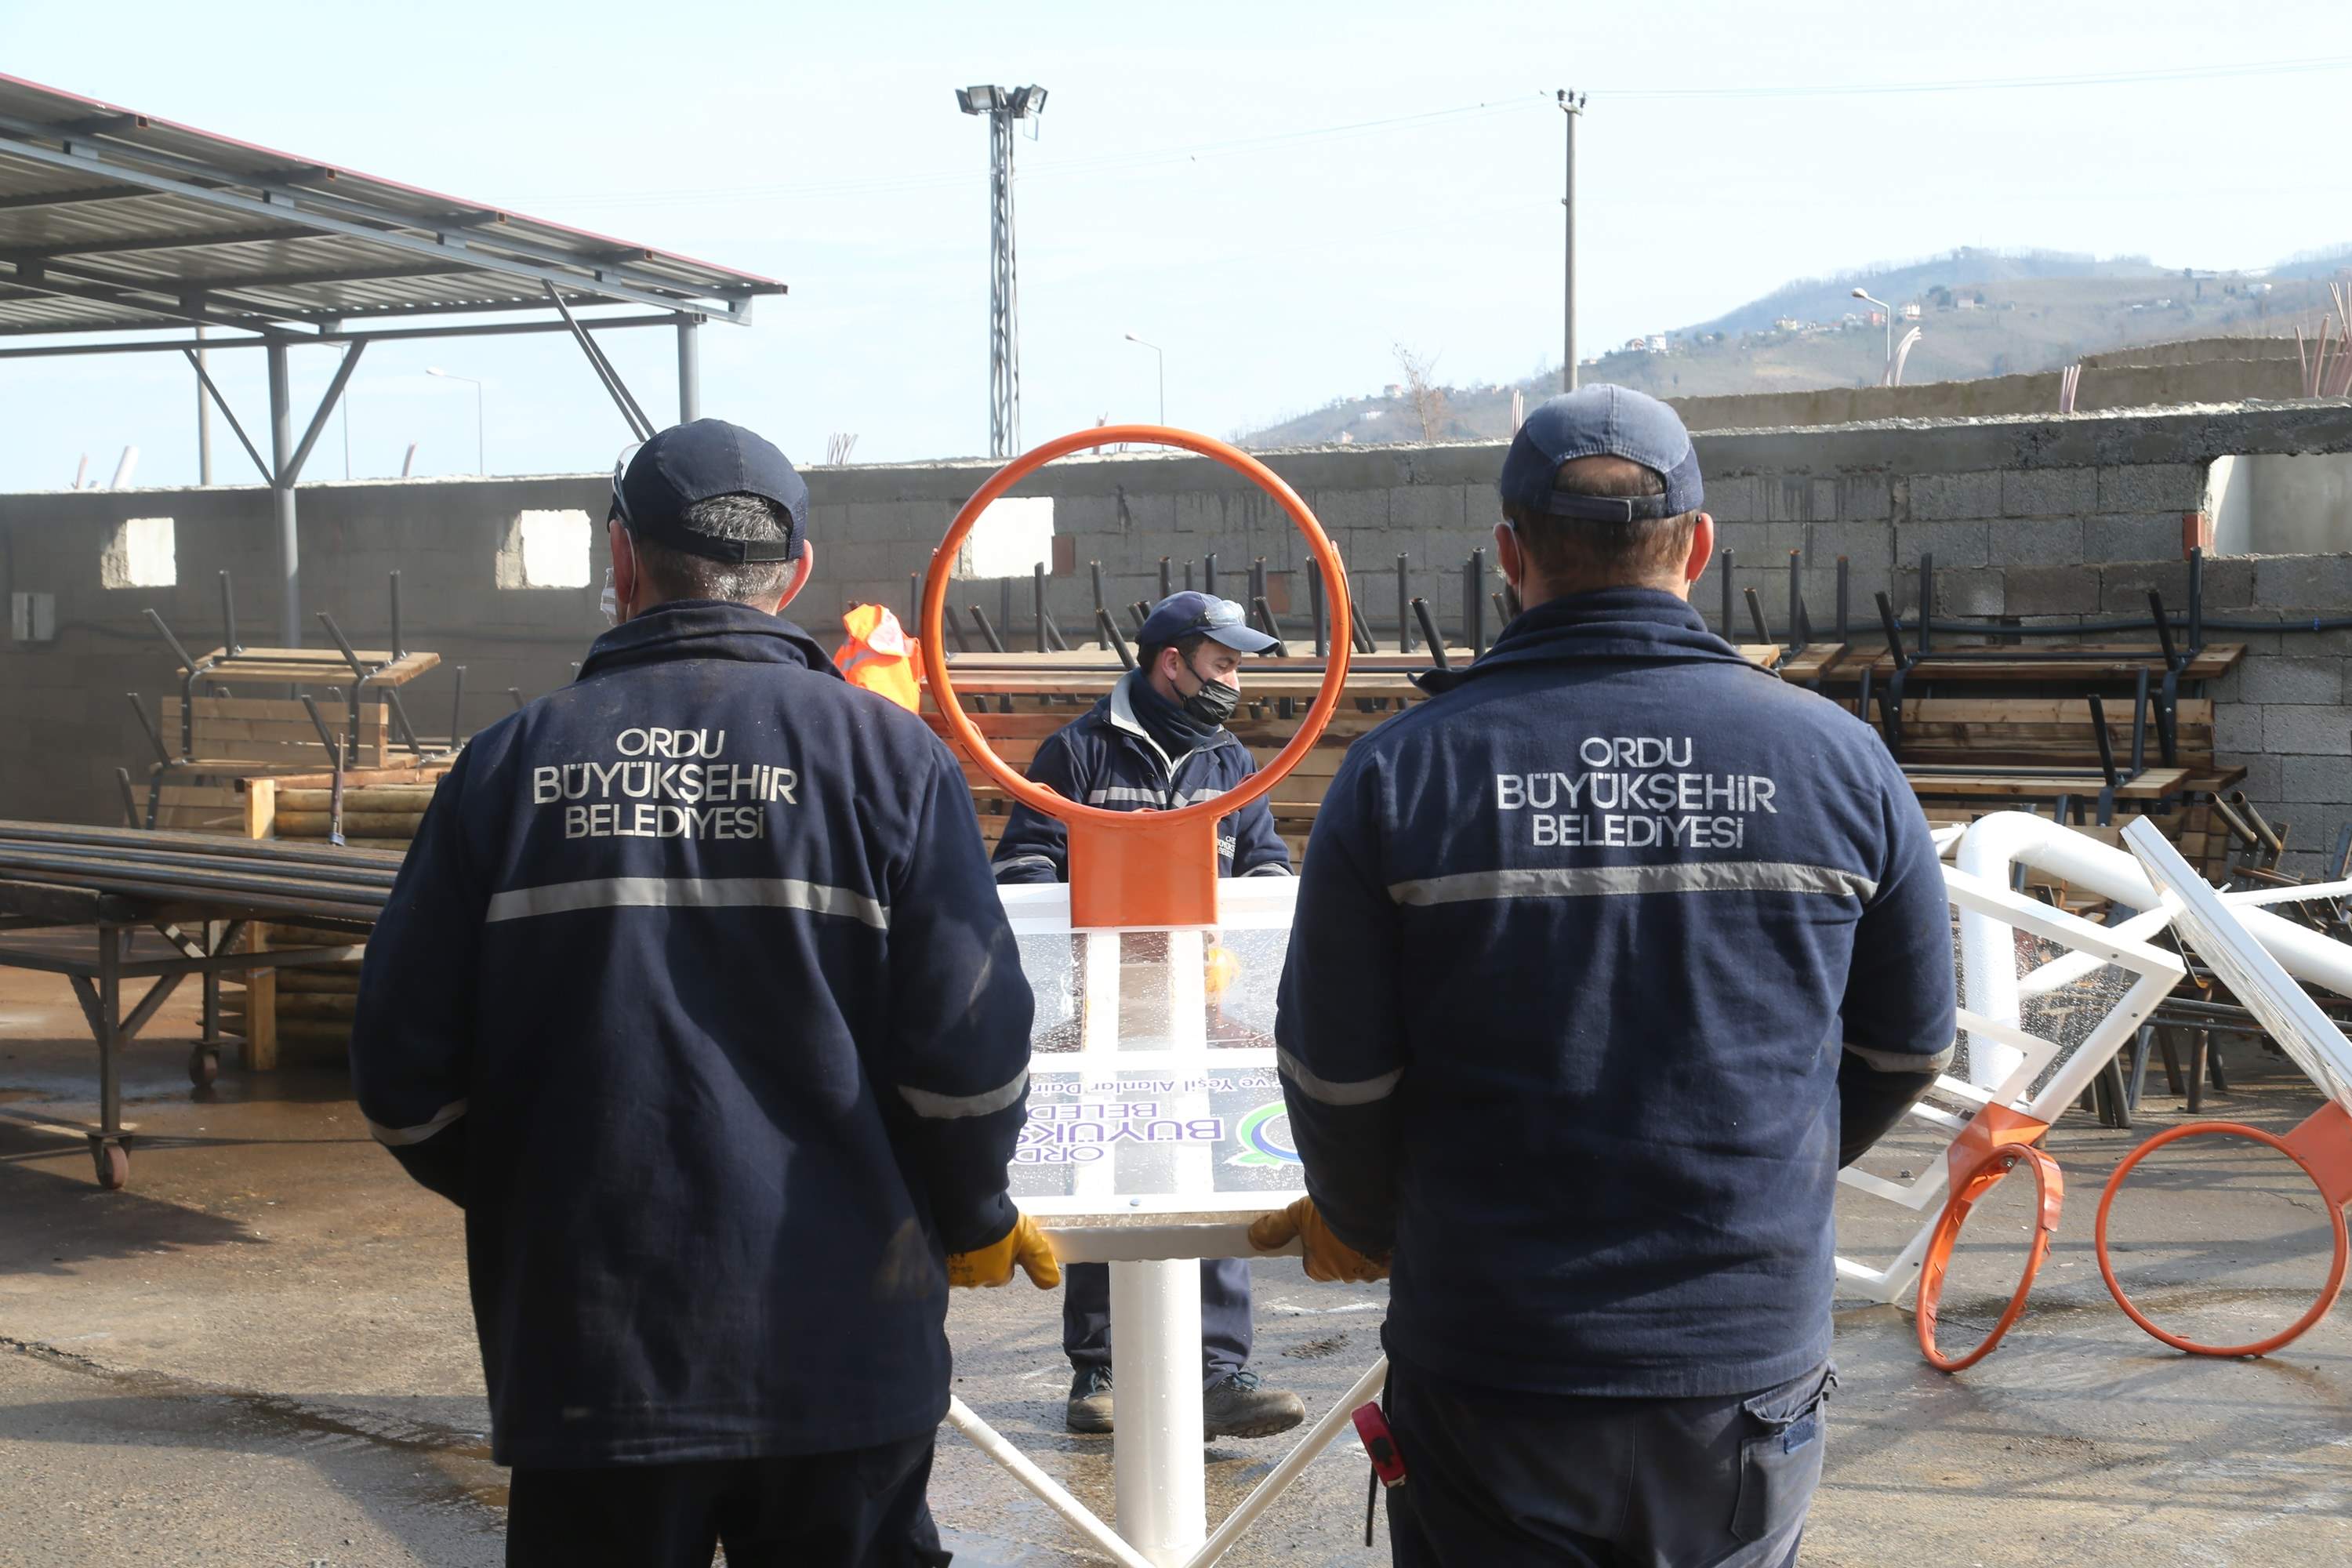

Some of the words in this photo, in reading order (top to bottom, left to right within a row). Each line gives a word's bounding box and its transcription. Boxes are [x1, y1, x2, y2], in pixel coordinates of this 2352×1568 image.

[616, 728, 724, 759] ORDU
[1580, 737, 1693, 768] ORDU
[534, 761, 797, 804] BÜYÜKŞEHİR
[1497, 772, 1777, 813] BÜYÜKŞEHİR
[565, 804, 764, 840] BELEDİYESİ
[1533, 815, 1744, 848] BELEDİYESİ
[1028, 1103, 1156, 1120] BELED
[1014, 1145, 1104, 1163] ORD
